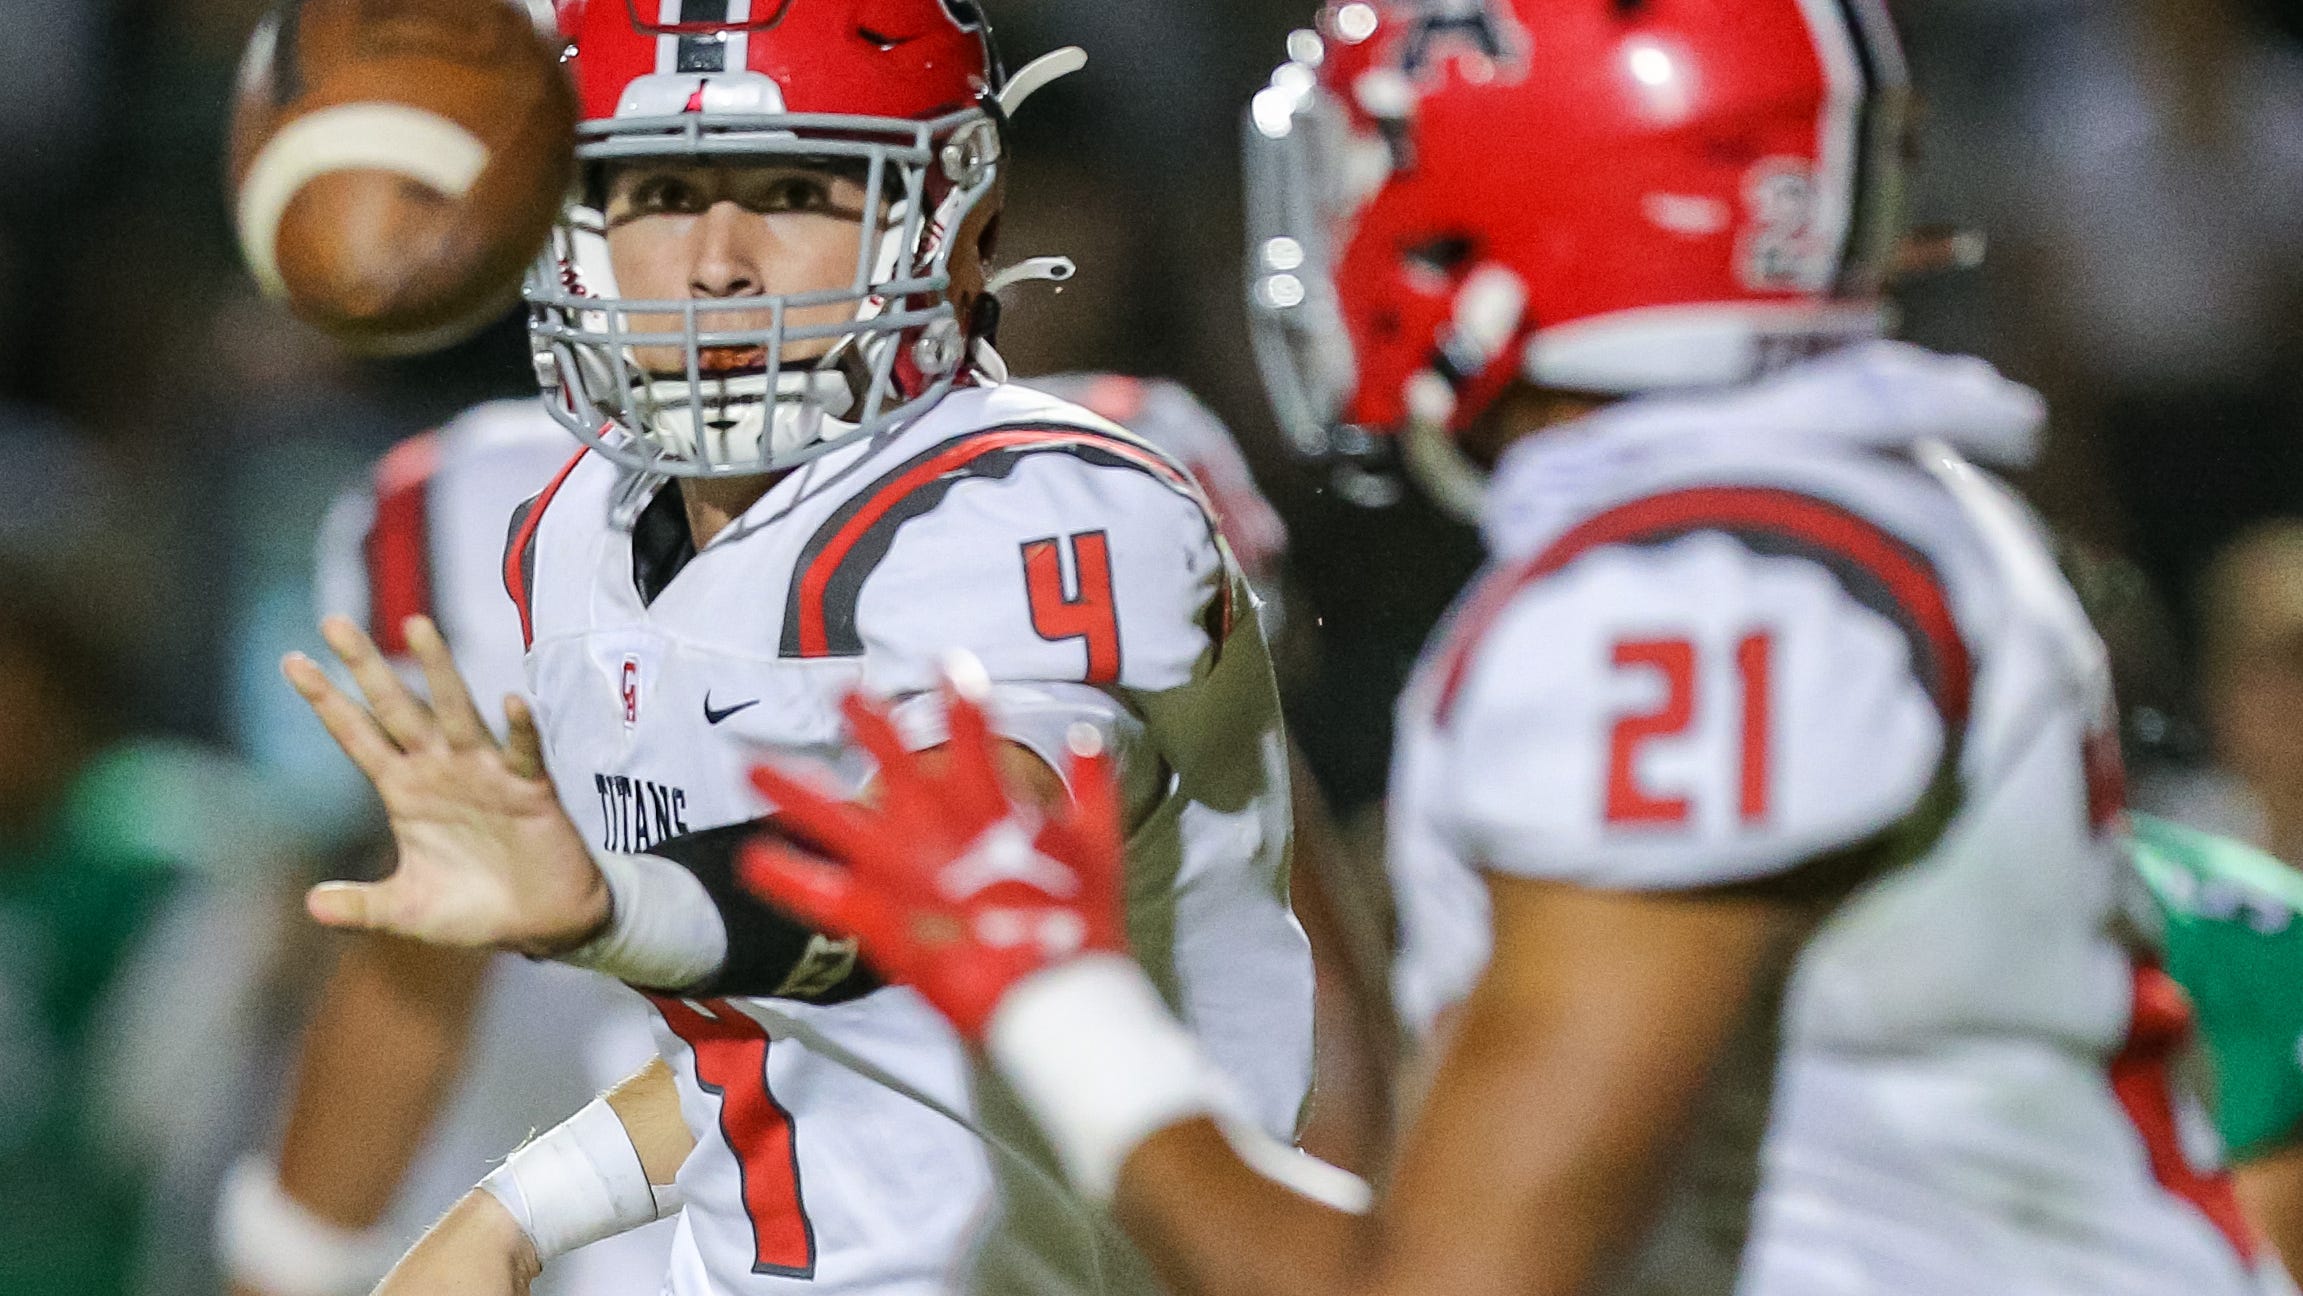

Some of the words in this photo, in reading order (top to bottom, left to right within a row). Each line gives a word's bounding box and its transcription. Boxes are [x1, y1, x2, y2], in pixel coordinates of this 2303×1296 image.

[1019, 529, 1124, 684] 4
[1603, 631, 1770, 824] 21
[595, 772, 688, 852] TITANS
